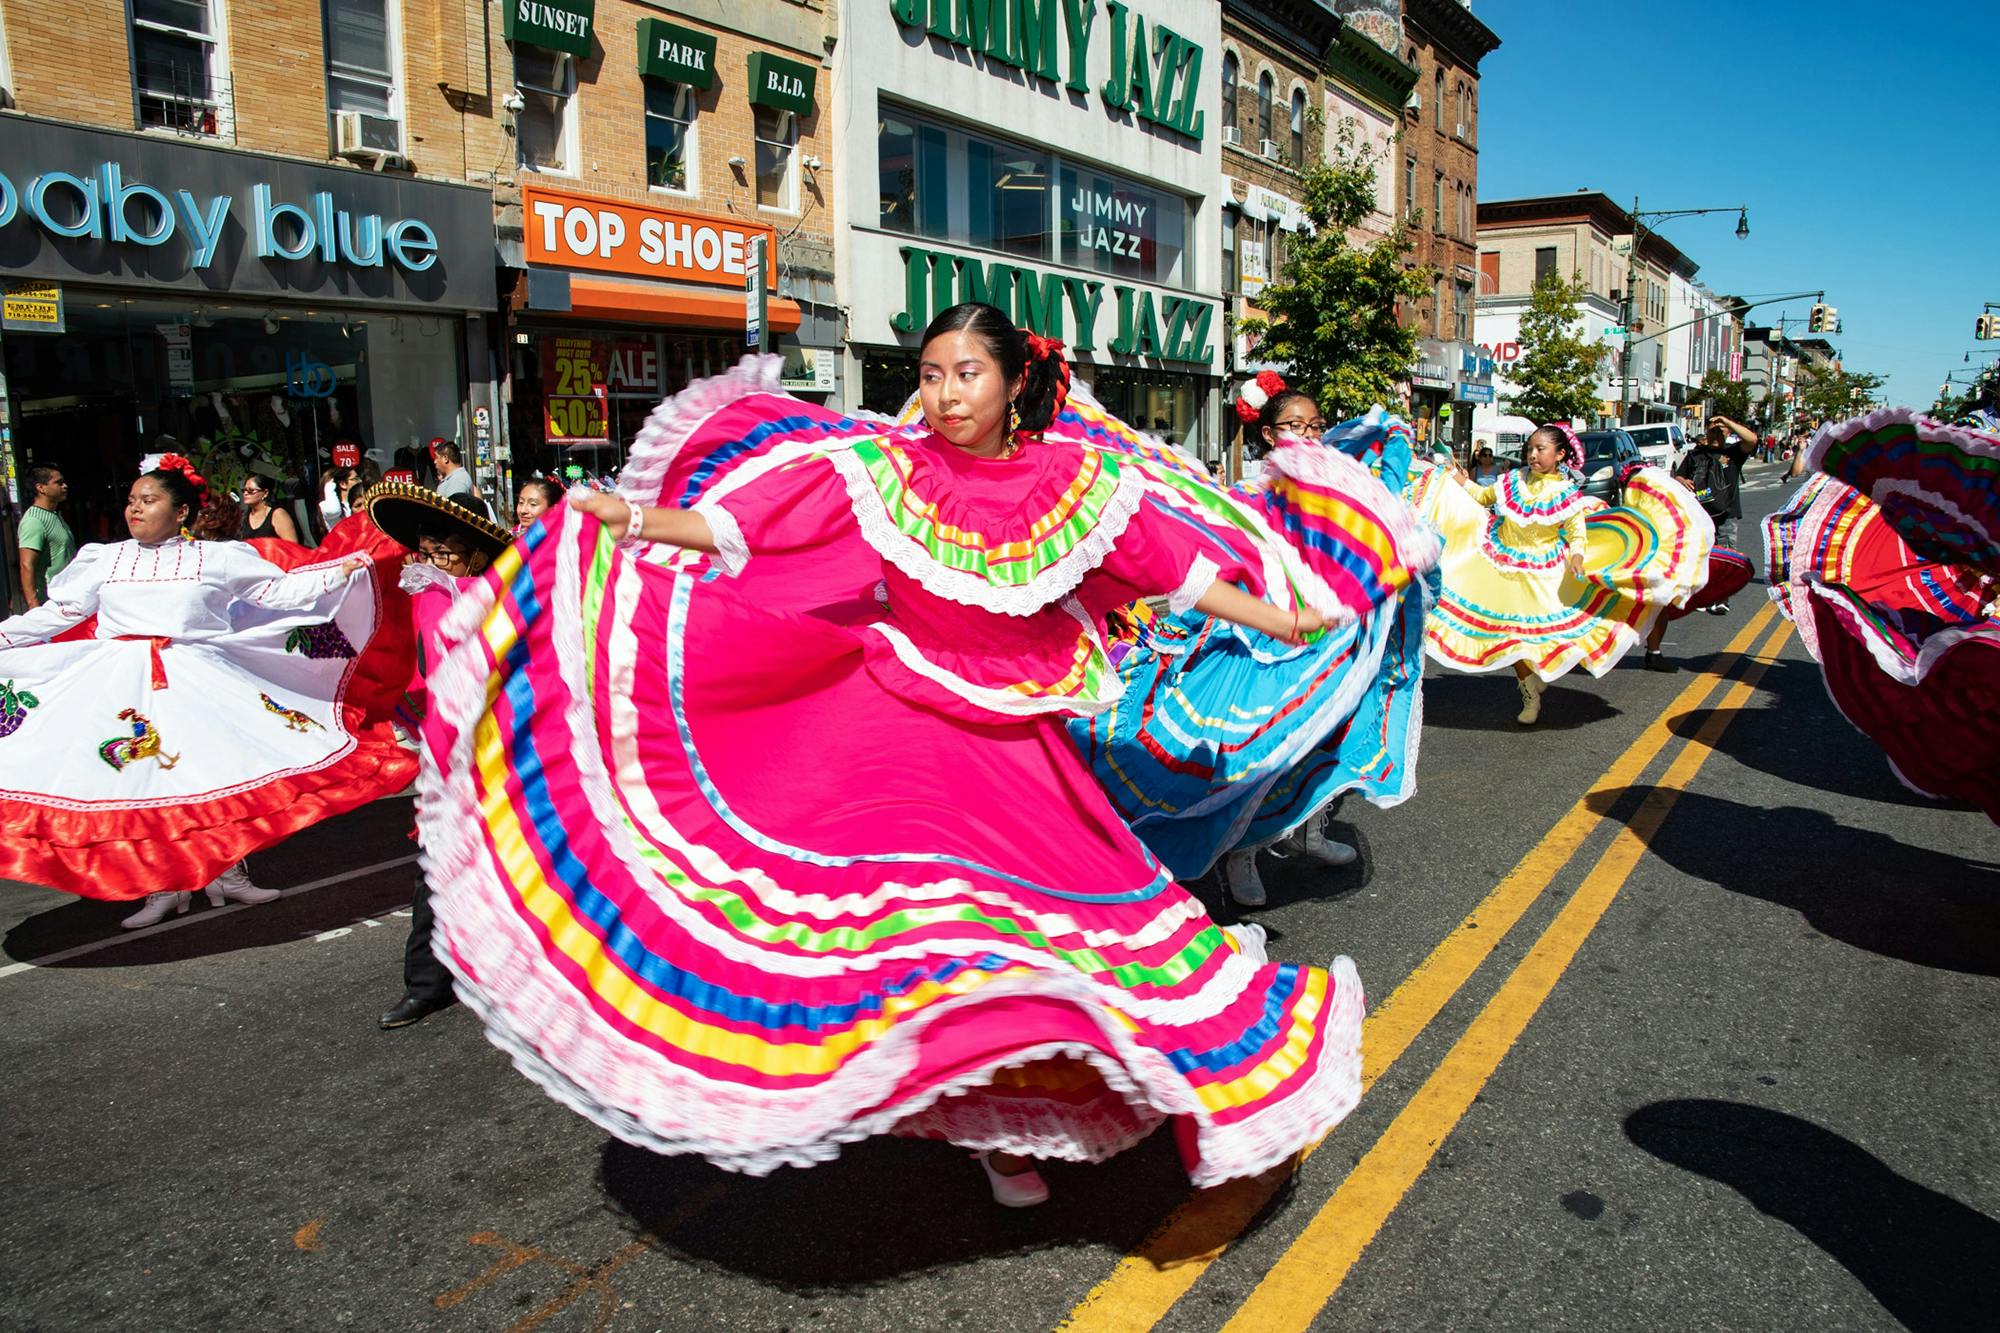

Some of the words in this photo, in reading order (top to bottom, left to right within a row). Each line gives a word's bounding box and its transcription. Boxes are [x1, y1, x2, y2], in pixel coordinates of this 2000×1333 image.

[518, 0, 588, 38] SUNSET
[658, 39, 706, 71] PARK
[1100, 0, 1203, 141] JAZZ
[767, 71, 806, 98] B.I.D.
[253, 183, 438, 271] blue
[1072, 188, 1146, 229] JIMMY
[534, 201, 625, 258] TOP
[639, 218, 768, 276] SHOE
[1080, 229, 1141, 259] JAZZ
[1108, 285, 1214, 364] JAZZ
[555, 358, 603, 396] 25%
[550, 399, 599, 436] 50%
[587, 421, 608, 437] OFF
[385, 475, 413, 485] SALE
